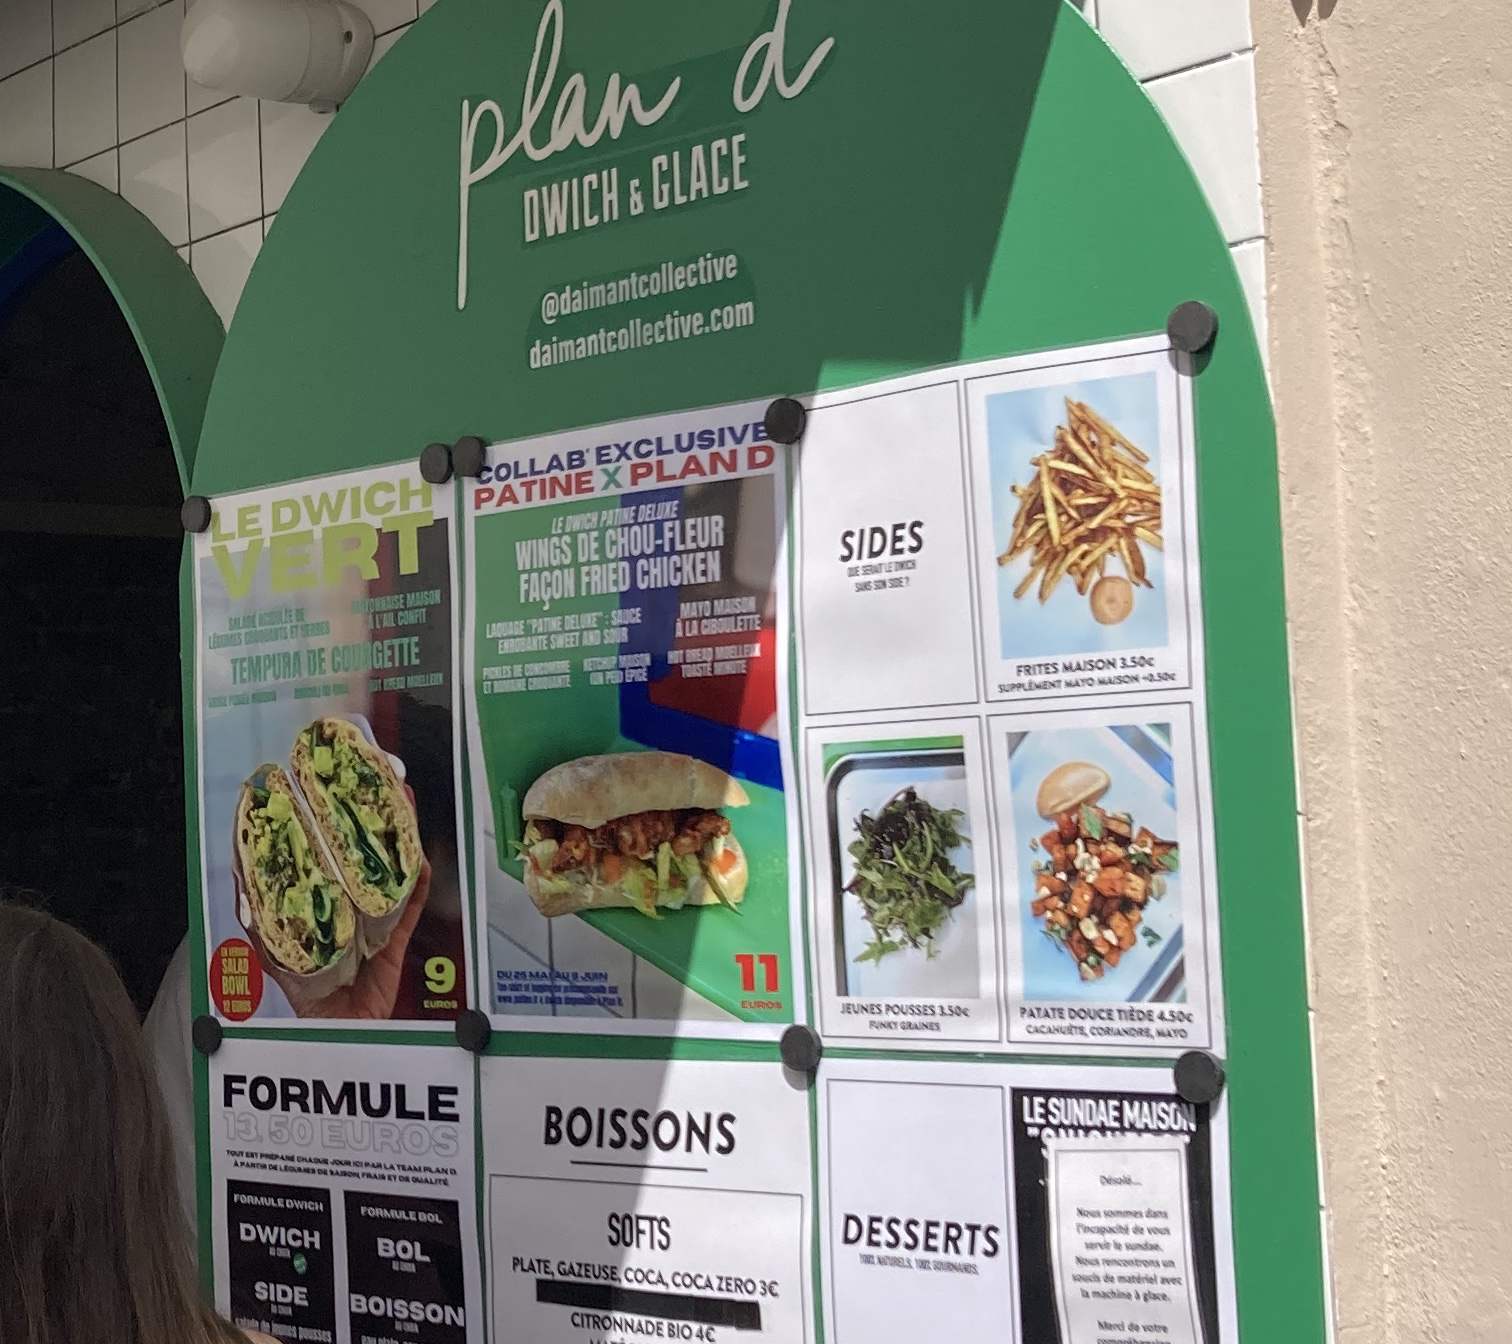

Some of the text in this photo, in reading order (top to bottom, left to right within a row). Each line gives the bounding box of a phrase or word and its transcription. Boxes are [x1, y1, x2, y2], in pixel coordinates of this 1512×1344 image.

[524, 133, 749, 243] DWICH & GLACE
[541, 252, 738, 325] @daimantcollective
[529, 300, 755, 370] daimantcollective.com
[596, 422, 769, 465] EXCLUSIVE
[474, 445, 776, 510] PATINE X PLAN D
[211, 477, 432, 543] LE DWICH
[552, 517, 563, 534] LE
[565, 510, 598, 533] DWICH
[638, 500, 679, 524] DELUXE
[211, 510, 434, 600] VERT
[516, 514, 725, 571] WINGS DE CHOU-FLEUR
[839, 520, 924, 562] SIDES
[519, 550, 721, 610] FAÇON FRIED CHICKEN
[680, 596, 756, 618] MAYO MAISON
[550, 630, 580, 649] SWEET
[582, 629, 602, 646] AND
[604, 627, 628, 644] SOUR
[686, 619, 698, 635] LA
[700, 614, 760, 634] CIBOULETTE
[231, 636, 420, 685] TEMPURA DE COURGETTE
[1016, 662, 1059, 676] FRITES
[1062, 658, 1117, 673] MAISON
[1064, 677, 1095, 688] MAYO
[1097, 674, 1140, 686] MAISON
[222, 958, 249, 975] SALAD
[424, 956, 456, 994] 9
[735, 954, 779, 993] 11
[222, 975, 251, 996] BOWL
[423, 999, 458, 1009] EUROS
[741, 1000, 783, 1010] EUROS
[840, 1002, 882, 1015] JEUNES
[885, 1003, 936, 1016] POUSSES
[1020, 1007, 1065, 1019] PATATE
[1068, 1008, 1113, 1021] DOUCE
[1116, 1006, 1155, 1022] TIÈDE
[869, 1020, 941, 1031] FUNKY GRAINES
[1156, 1028, 1188, 1038] MAYO
[223, 1074, 460, 1122] FORMULE
[1023, 1095, 1197, 1132] LE SUNDAE MAISON
[320, 1118, 459, 1157] EUROS
[544, 1104, 736, 1156] BOISSONS
[233, 1193, 324, 1212] FORMULE DWICH
[361, 1206, 443, 1224] FORMULE BOL
[1076, 1207, 1169, 1219] Nous sommes dans
[239, 1222, 321, 1250] DWICH
[607, 1212, 671, 1251] SOFTS
[842, 1213, 1000, 1257] DESSERTS
[1132, 1224, 1144, 1234] de
[1146, 1226, 1170, 1235] vous
[377, 1237, 431, 1262] BOL
[1075, 1256, 1175, 1268] Nous rencontrons un
[512, 1256, 779, 1297] PLATE, GAZEUSE, COCA, COCA ZERO 3€
[1103, 1273, 1115, 1283] de
[1117, 1274, 1158, 1285] matériel
[1160, 1276, 1182, 1285] avec
[254, 1281, 309, 1306] SIDE
[1091, 1289, 1132, 1300] machine
[350, 1293, 465, 1327] BOISSON
[571, 1312, 716, 1344] CITRONNADE BIO 4€
[1097, 1320, 1169, 1333] Merci de votre
